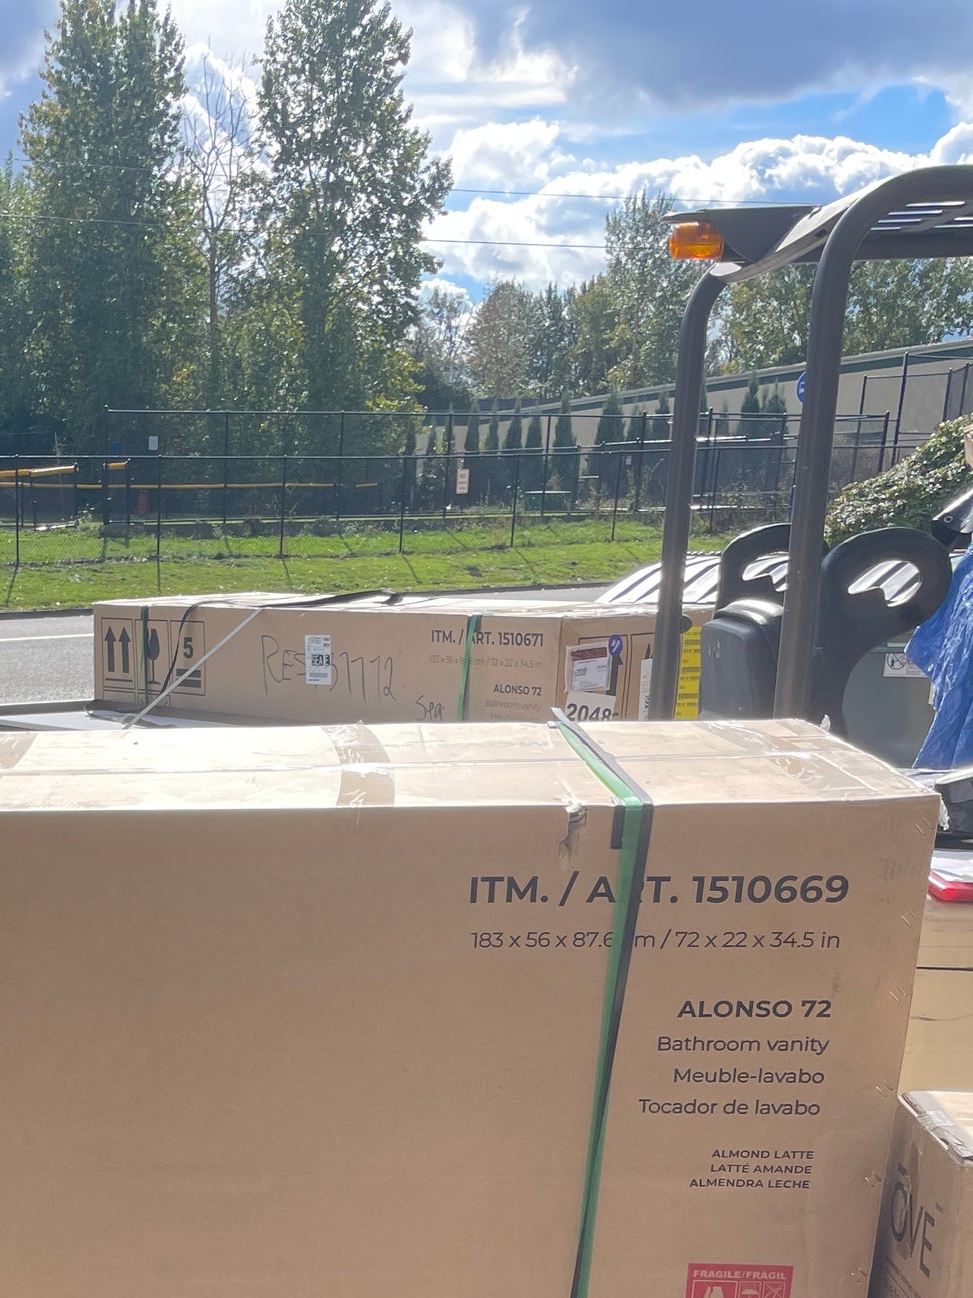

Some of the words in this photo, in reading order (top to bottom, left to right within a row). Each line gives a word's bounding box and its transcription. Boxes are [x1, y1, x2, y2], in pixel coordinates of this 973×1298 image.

[431, 629, 456, 644] ITM.
[498, 632, 544, 648] 1510671
[493, 684, 530, 696] ALONSO
[532, 686, 542, 697] 72
[469, 875, 549, 904] ITM.
[558, 870, 580, 907] /
[585, 875, 679, 904] AT.
[692, 874, 850, 904] 1510669
[470, 932, 504, 948] 183
[509, 935, 521, 948] x
[525, 931, 551, 948] 56
[555, 935, 568, 948] x
[660, 928, 672, 950] /
[675, 931, 700, 948] 72
[704, 935, 718, 948] x
[721, 931, 748, 948] 22
[752, 935, 765, 948] x
[769, 931, 815, 948] 34.5
[821, 931, 841, 949] in
[677, 1000, 793, 1018] ALONSO
[801, 1000, 832, 1018] 72
[657, 1036, 761, 1051] Bathroom
[767, 1036, 830, 1056] vanity
[673, 1067, 825, 1084] Meuble-lavabo
[638, 1098, 718, 1114] Tocador
[723, 1099, 749, 1115] de
[755, 1099, 821, 1116] lavabo
[711, 1149, 770, 1159] ALMOND
[774, 1150, 815, 1160] LATTE
[753, 1165, 813, 1174] AMANDE
[689, 1178, 764, 1188] ALMENDRA
[768, 1179, 810, 1189] LECHE
